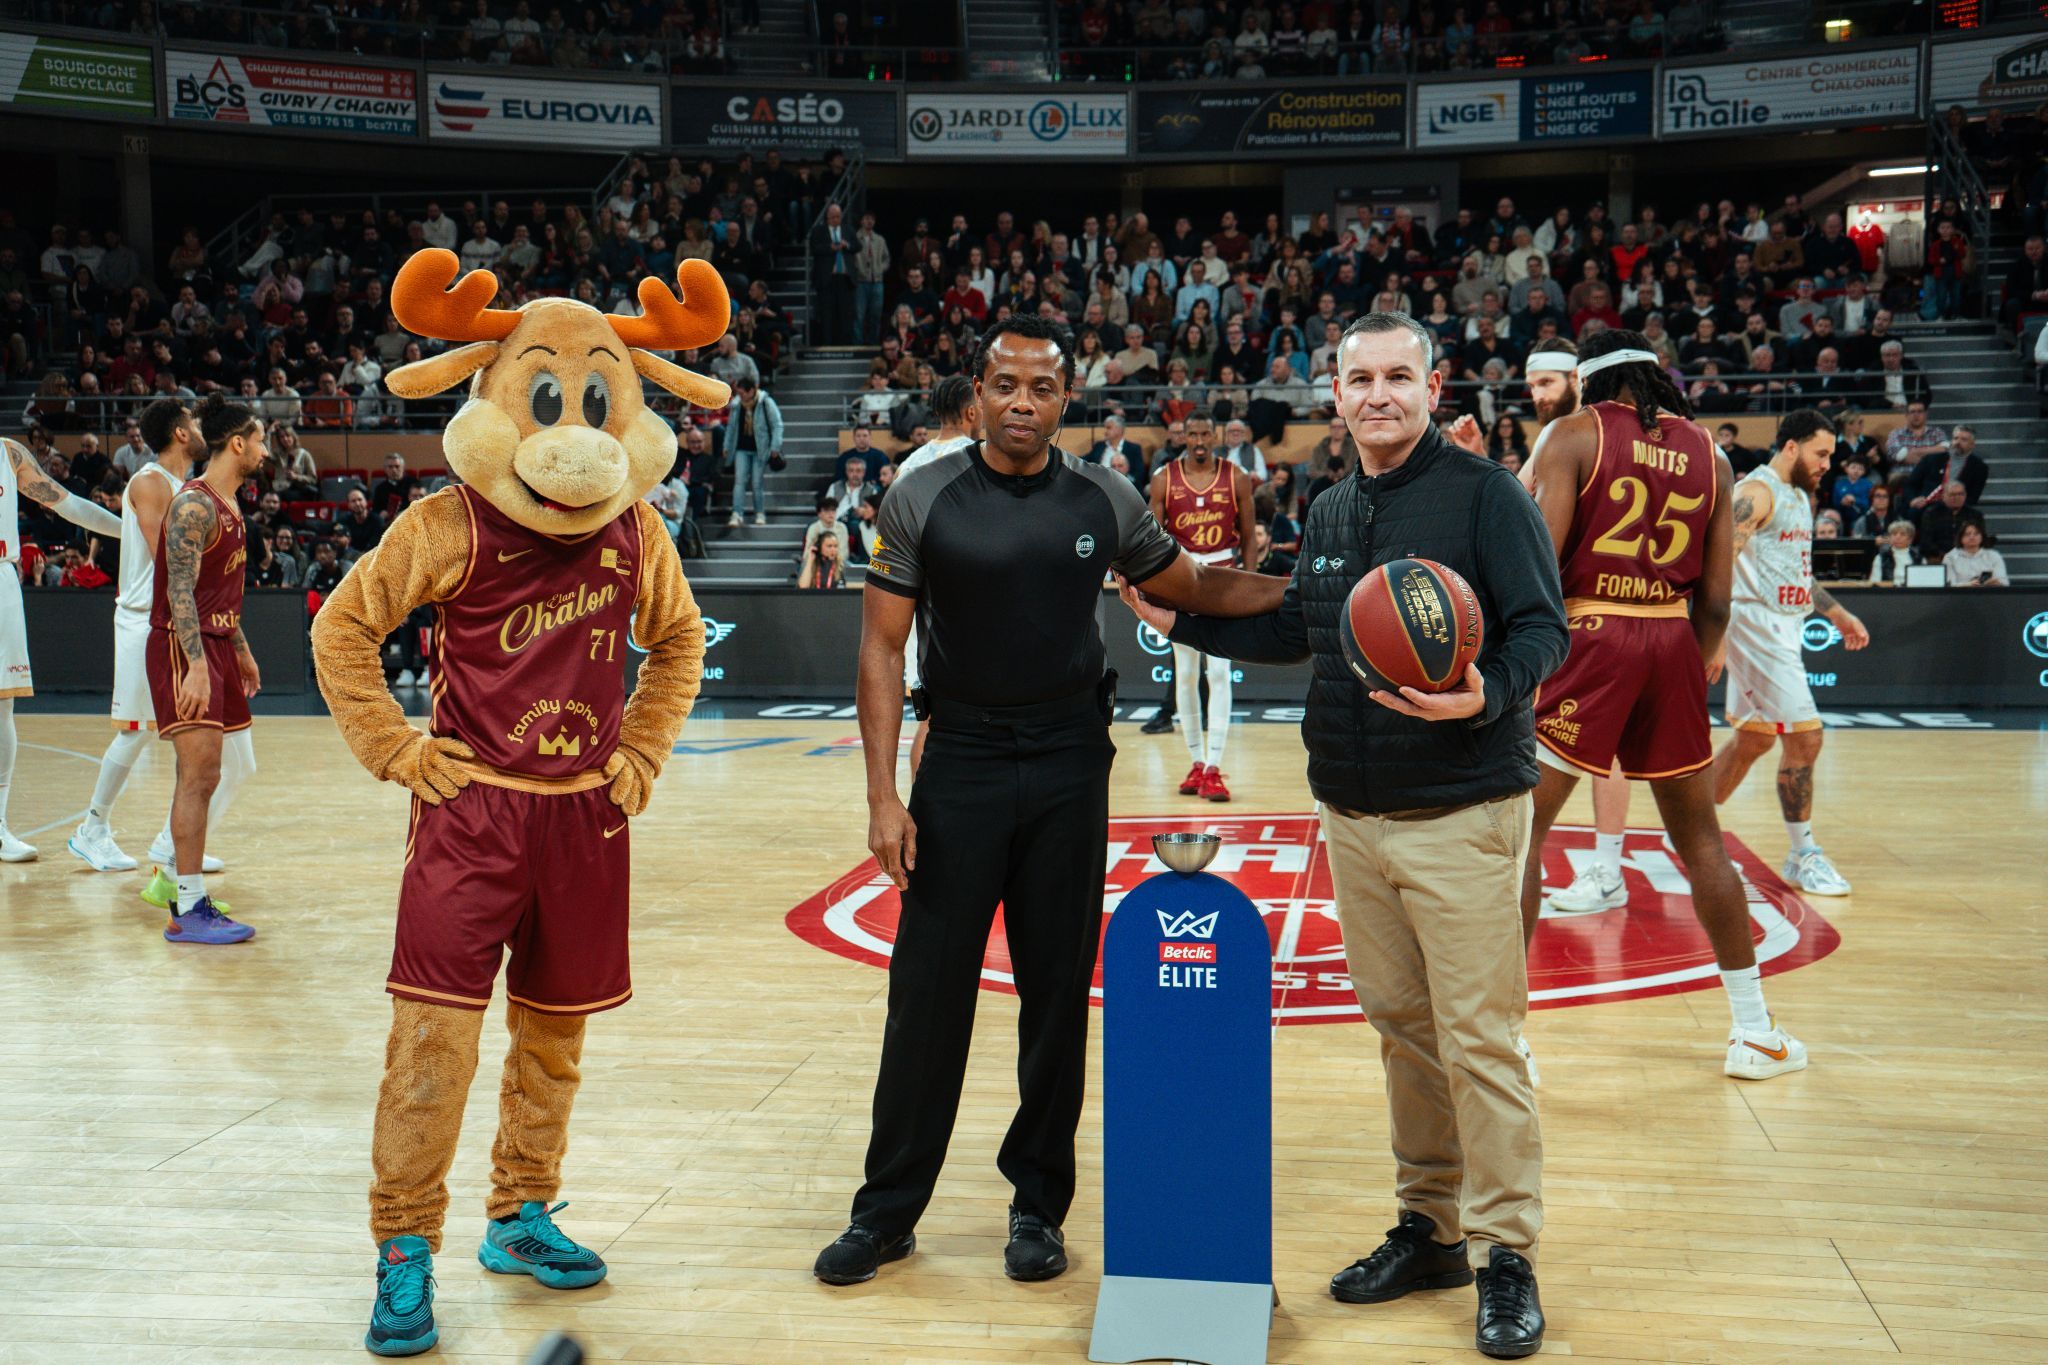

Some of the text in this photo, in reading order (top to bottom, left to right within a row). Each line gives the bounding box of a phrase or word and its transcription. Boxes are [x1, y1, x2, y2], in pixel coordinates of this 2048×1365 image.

[43, 58, 137, 80] BOURGOGNE
[246, 63, 385, 83] CHAUFFAGE CLIMATISATION
[49, 75, 134, 94] RECYCLAGE
[176, 79, 246, 109] BCS
[272, 78, 384, 95] PLOMBERIE SANITAIRE
[1548, 82, 1585, 95] EHTP
[259, 92, 318, 111] GIVRY
[334, 98, 412, 117] CHAGNY
[727, 93, 844, 124] CASÉO
[1279, 90, 1402, 111] Construction
[1547, 92, 1637, 109] NGE ROUTES
[308, 115, 322, 127] 91
[343, 117, 355, 129] 15
[502, 99, 654, 126] EUROVIA
[947, 109, 1024, 127] JARDI
[1267, 111, 1375, 130] Rénovation
[1440, 104, 1494, 125] NGE
[1547, 108, 1615, 123] GUINTOLI
[1669, 100, 1770, 130] Thalie
[711, 124, 766, 135] CUISINES
[782, 126, 860, 137] MENUISERIES
[1547, 122, 1599, 136] NGE GC
[1247, 133, 1307, 147] Particuliers
[1633, 440, 1688, 476] MUTTS
[1592, 476, 1705, 564] 25
[1190, 525, 1222, 546] 40
[869, 558, 890, 576] OSTE
[1409, 568, 1450, 645] LEGACY
[500, 583, 619, 653] Chalon
[590, 628, 617, 662] 71
[507, 699, 560, 744] family
[1163, 945, 1212, 960] Betclic
[1159, 964, 1217, 989] ÉLITE
